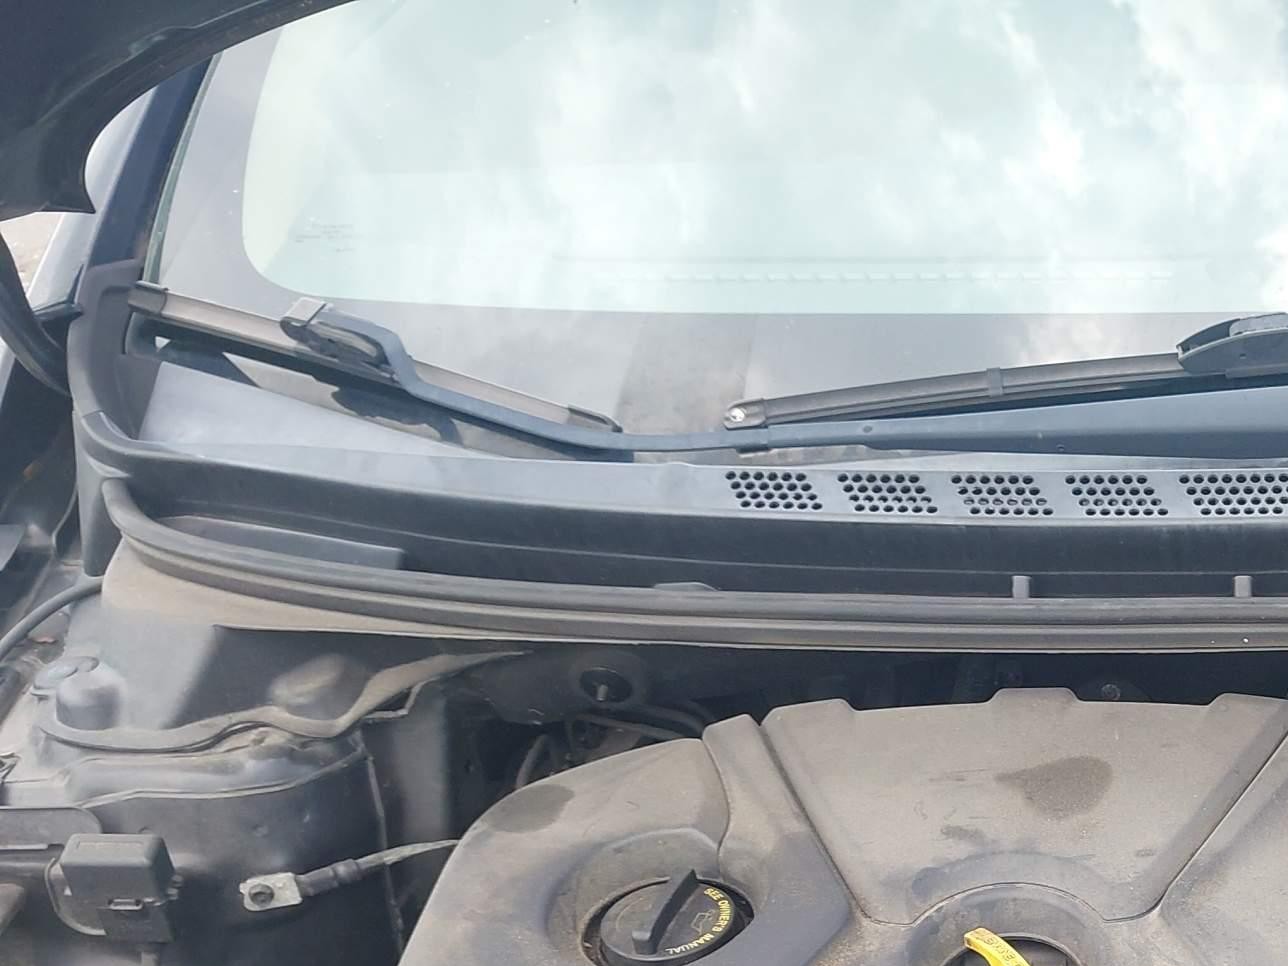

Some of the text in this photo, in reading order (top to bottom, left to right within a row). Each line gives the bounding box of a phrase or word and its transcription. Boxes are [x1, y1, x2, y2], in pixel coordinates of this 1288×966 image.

[665, 888, 731, 954] SEE OWNER'S MANUAL
